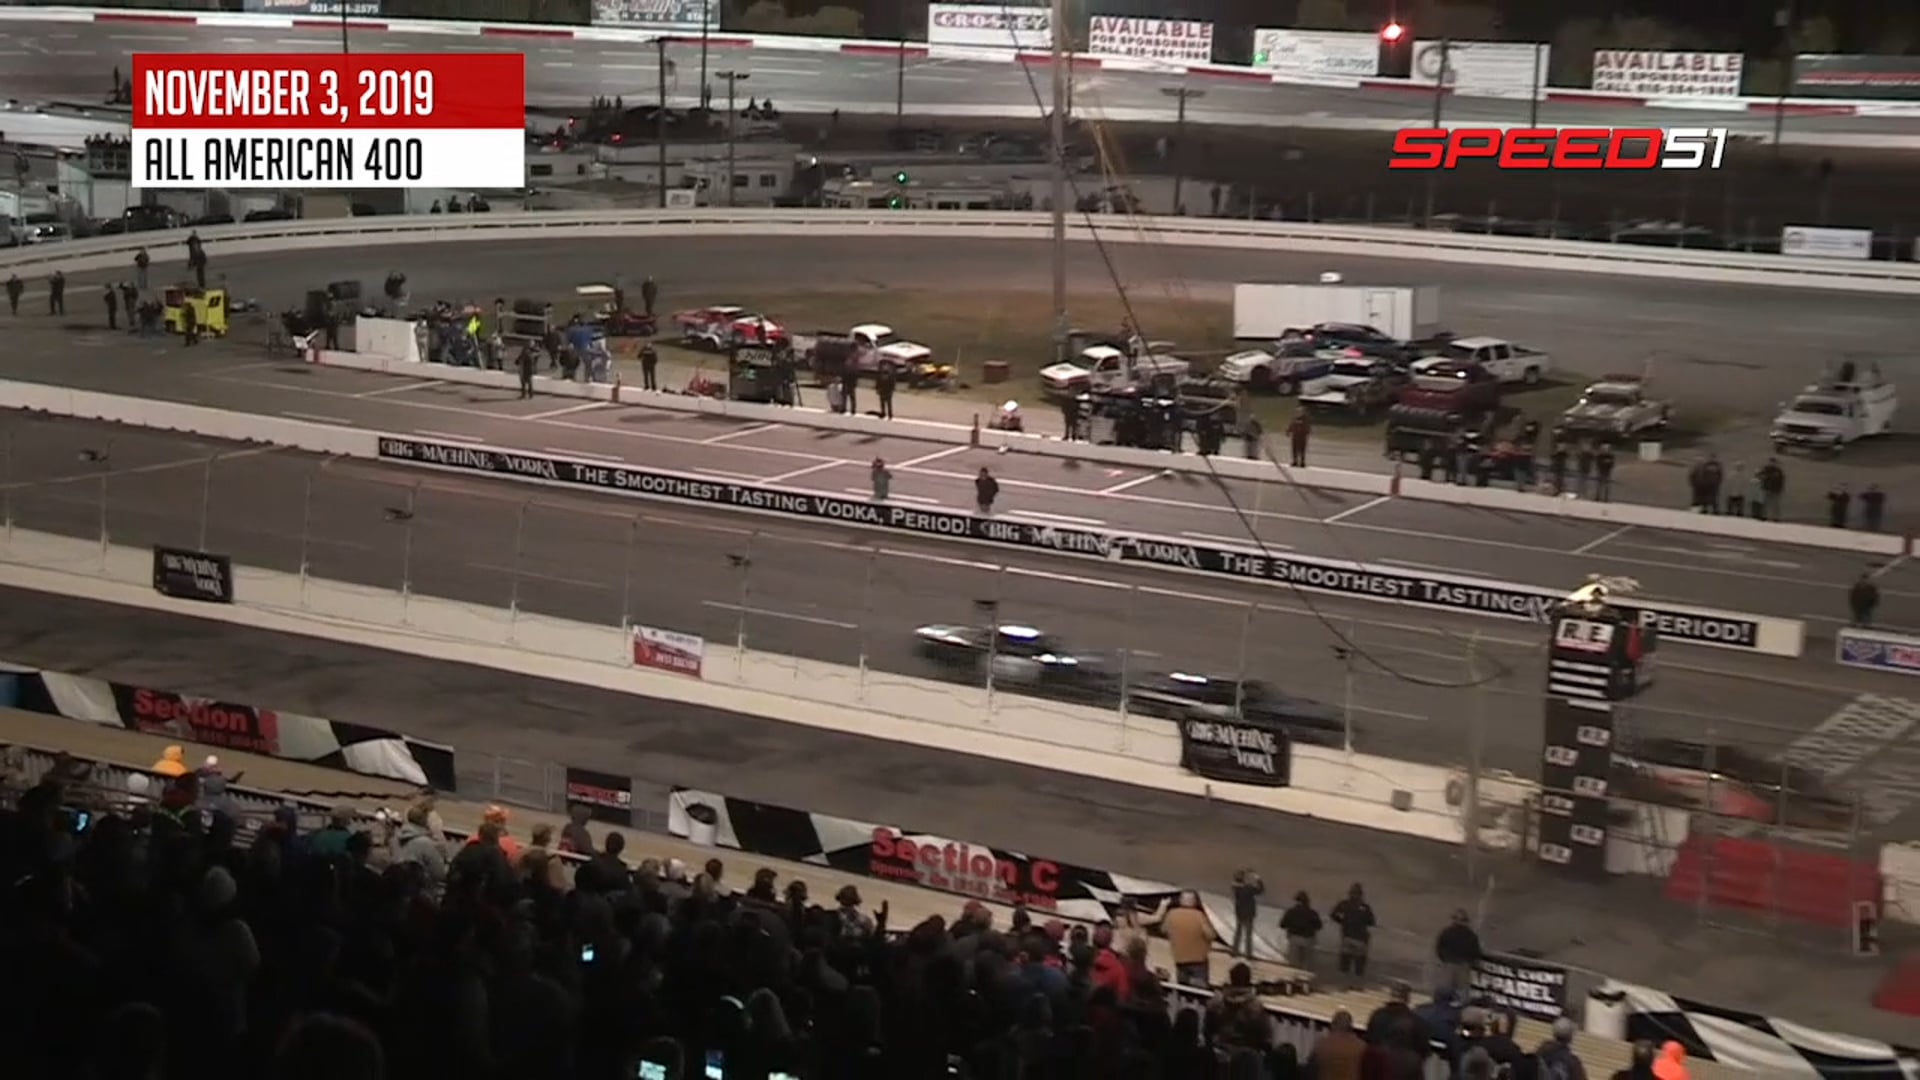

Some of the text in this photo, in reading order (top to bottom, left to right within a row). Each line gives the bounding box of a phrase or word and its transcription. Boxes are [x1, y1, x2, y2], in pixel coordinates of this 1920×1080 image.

[1091, 34, 1209, 48] FOR SPONSORSHIP
[1092, 17, 1211, 38] AVAILABLE
[1598, 51, 1741, 71] AVAILABLE
[1631, 72, 1737, 83] SPONSORSHIP
[381, 439, 413, 457] BIG
[416, 444, 495, 471] MACHINE
[501, 454, 560, 480] VODKA
[572, 464, 608, 484] THE
[615, 470, 723, 498] SMOOTHEST
[728, 485, 808, 512] TASTING
[891, 508, 972, 536] PERIOD!
[980, 521, 1020, 542] BIG
[1130, 537, 1201, 568] VODKA
[1219, 551, 1265, 576] THE
[1273, 560, 1413, 597] SMOOTHEST
[1638, 610, 1751, 643] PERIOD!
[134, 688, 248, 732] Section
[872, 827, 1059, 892] Section C
[1468, 970, 1556, 1003] APPAREL
